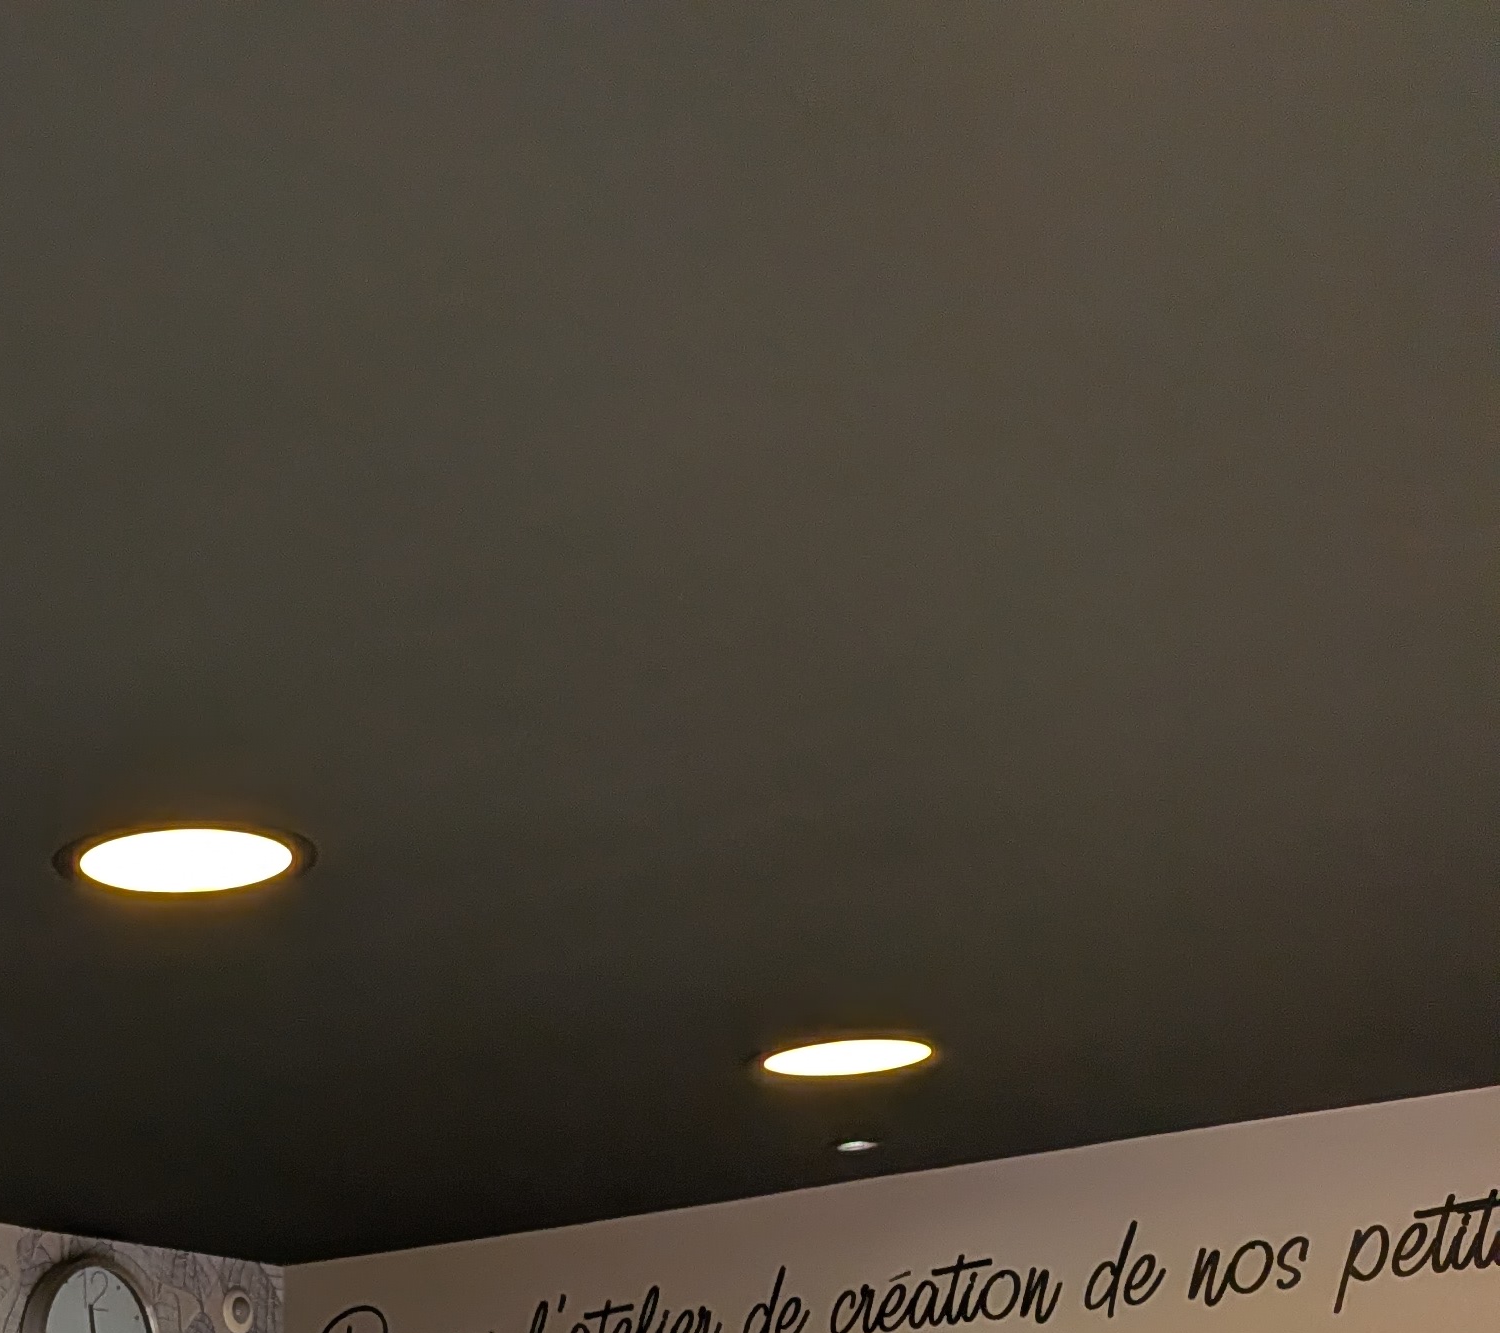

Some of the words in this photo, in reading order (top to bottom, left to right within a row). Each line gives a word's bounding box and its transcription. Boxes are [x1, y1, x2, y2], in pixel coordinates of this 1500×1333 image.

[1084, 1220, 1167, 1318] de
[1187, 1235, 1310, 1307] nos
[1333, 1188, 1500, 1314] petit
